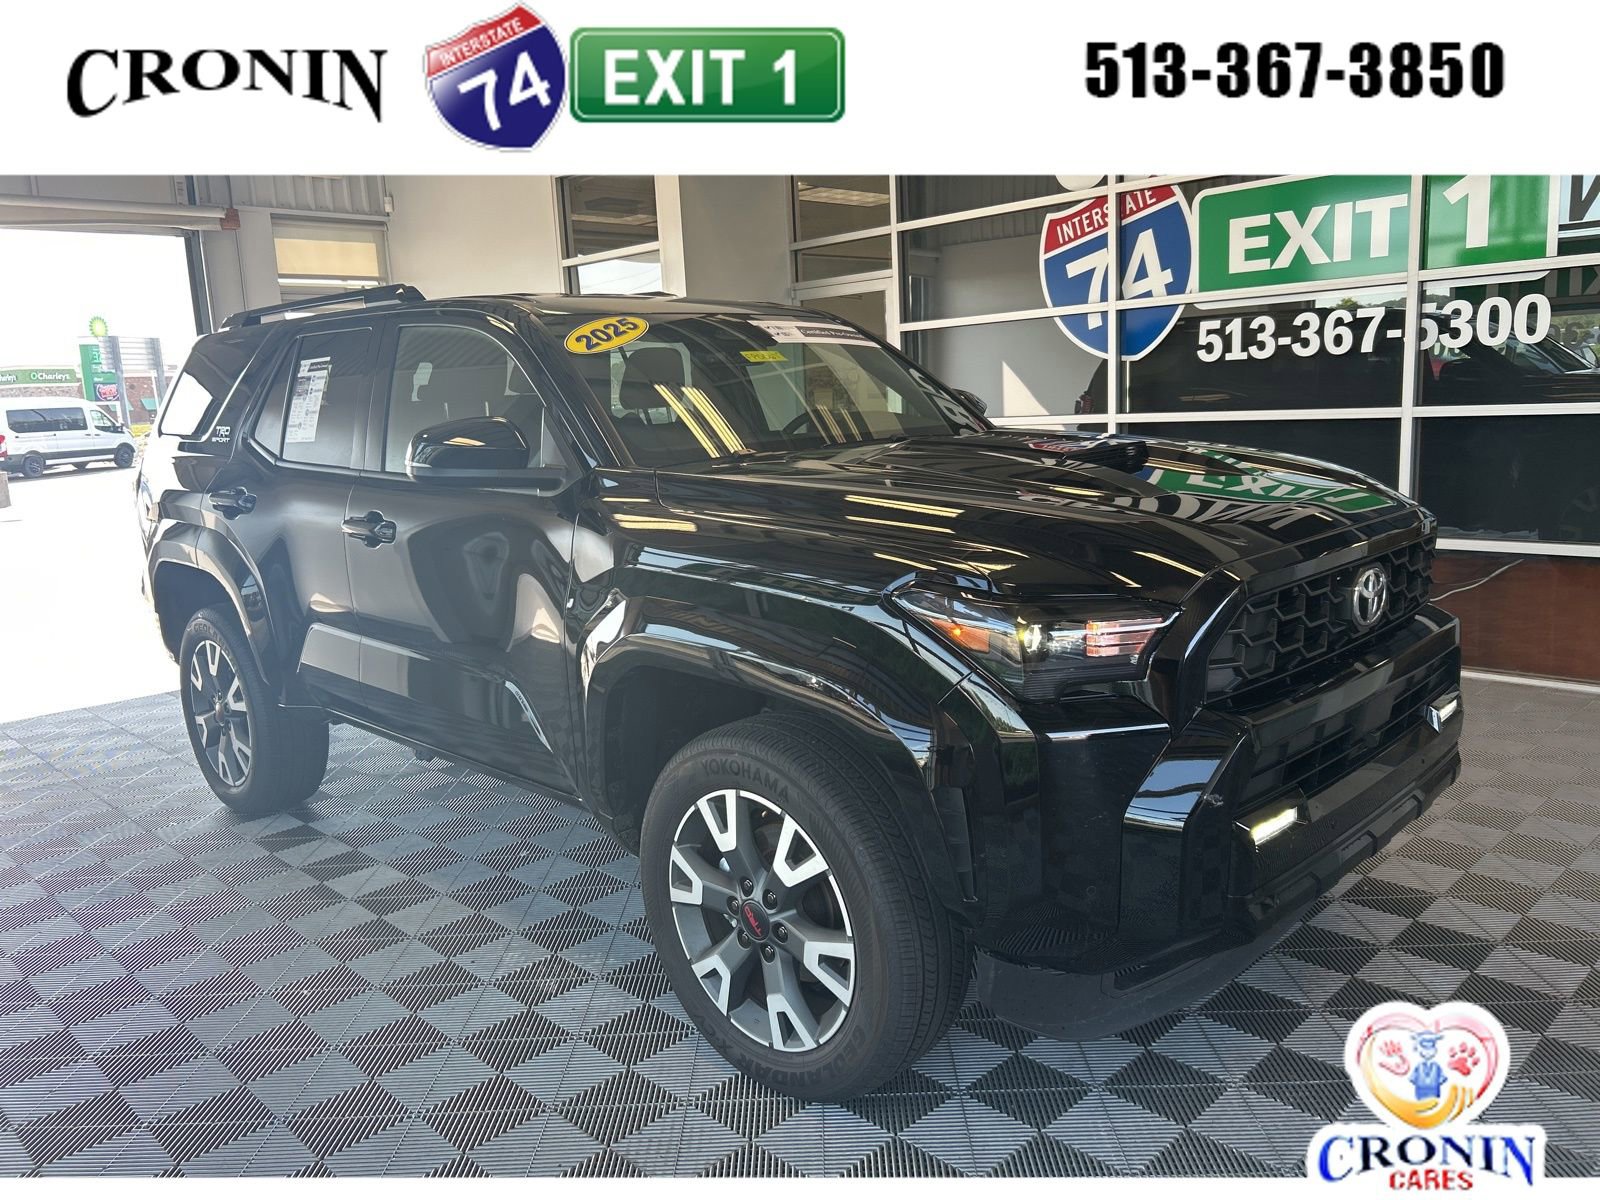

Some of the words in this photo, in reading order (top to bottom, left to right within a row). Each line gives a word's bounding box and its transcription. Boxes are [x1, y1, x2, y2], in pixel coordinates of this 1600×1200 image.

[1056, 190, 1157, 244] INTERSATE
[1229, 193, 1408, 274] EXIT
[1442, 175, 1491, 248] 1
[1065, 228, 1174, 330] 74
[575, 318, 639, 350] 2025
[215, 425, 231, 437] TRD
[701, 758, 789, 803] YOKOHAMA
